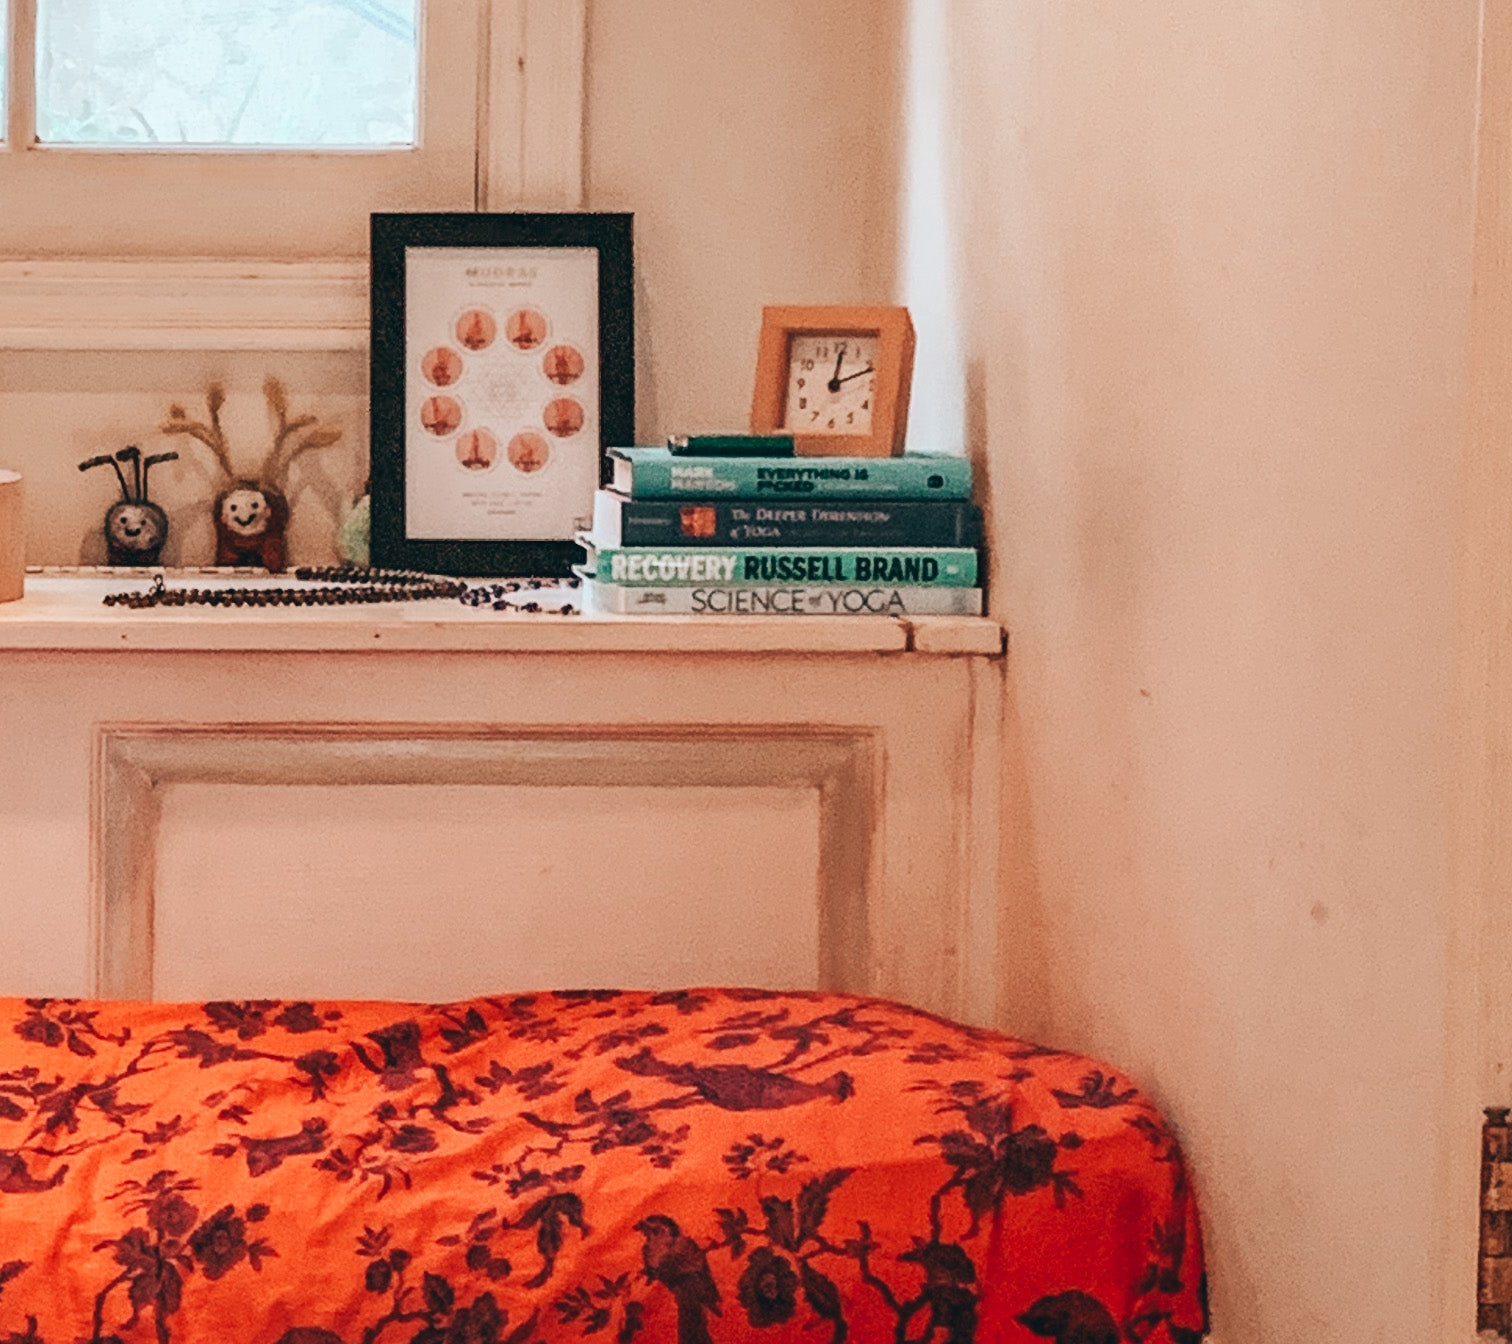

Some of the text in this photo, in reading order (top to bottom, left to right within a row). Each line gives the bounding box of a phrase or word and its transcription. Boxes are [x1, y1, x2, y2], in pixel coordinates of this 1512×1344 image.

[810, 411, 820, 422] 7
[757, 468, 869, 480] EVERYTHING IS
[611, 555, 939, 582] RECOVERY RUSSELL BRAND
[691, 588, 805, 612] SCIENCE
[826, 588, 908, 612] YOGA
